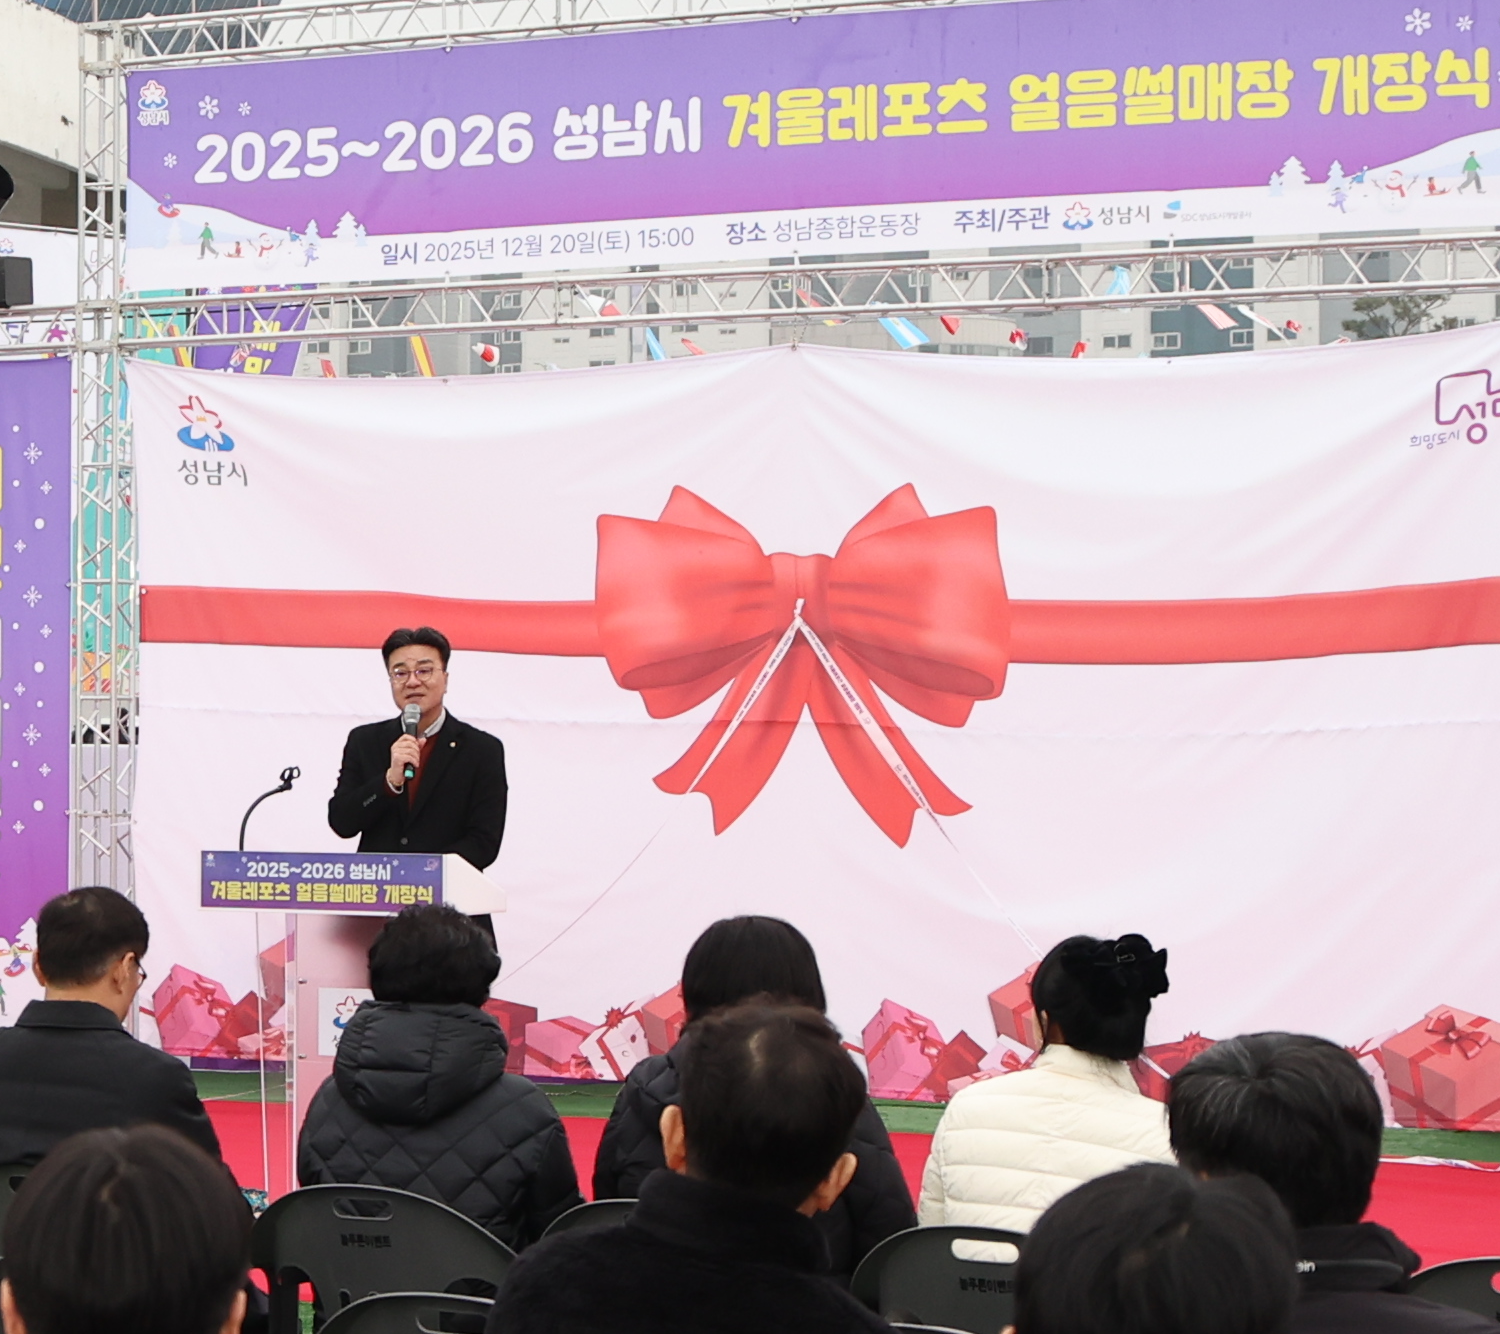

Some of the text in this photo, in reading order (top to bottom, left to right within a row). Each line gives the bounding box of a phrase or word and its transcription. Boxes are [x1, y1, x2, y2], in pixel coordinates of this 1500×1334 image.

[137, 110, 170, 125] 성남시
[194, 47, 1490, 185] 2025~2026 성남시 겨울레포츠 얼음썰매장 개장식
[381, 205, 1150, 265] 일시 2025년 12월 20일(토) 15:00 장소 성남종합운동장 주최/주관 성남시
[1409, 430, 1460, 450] 희망도시
[178, 460, 248, 487] 성남시
[247, 861, 391, 880] 2025~2026 성남시
[211, 881, 434, 904] 겨울레포츠 얼음썰매장 개장식
